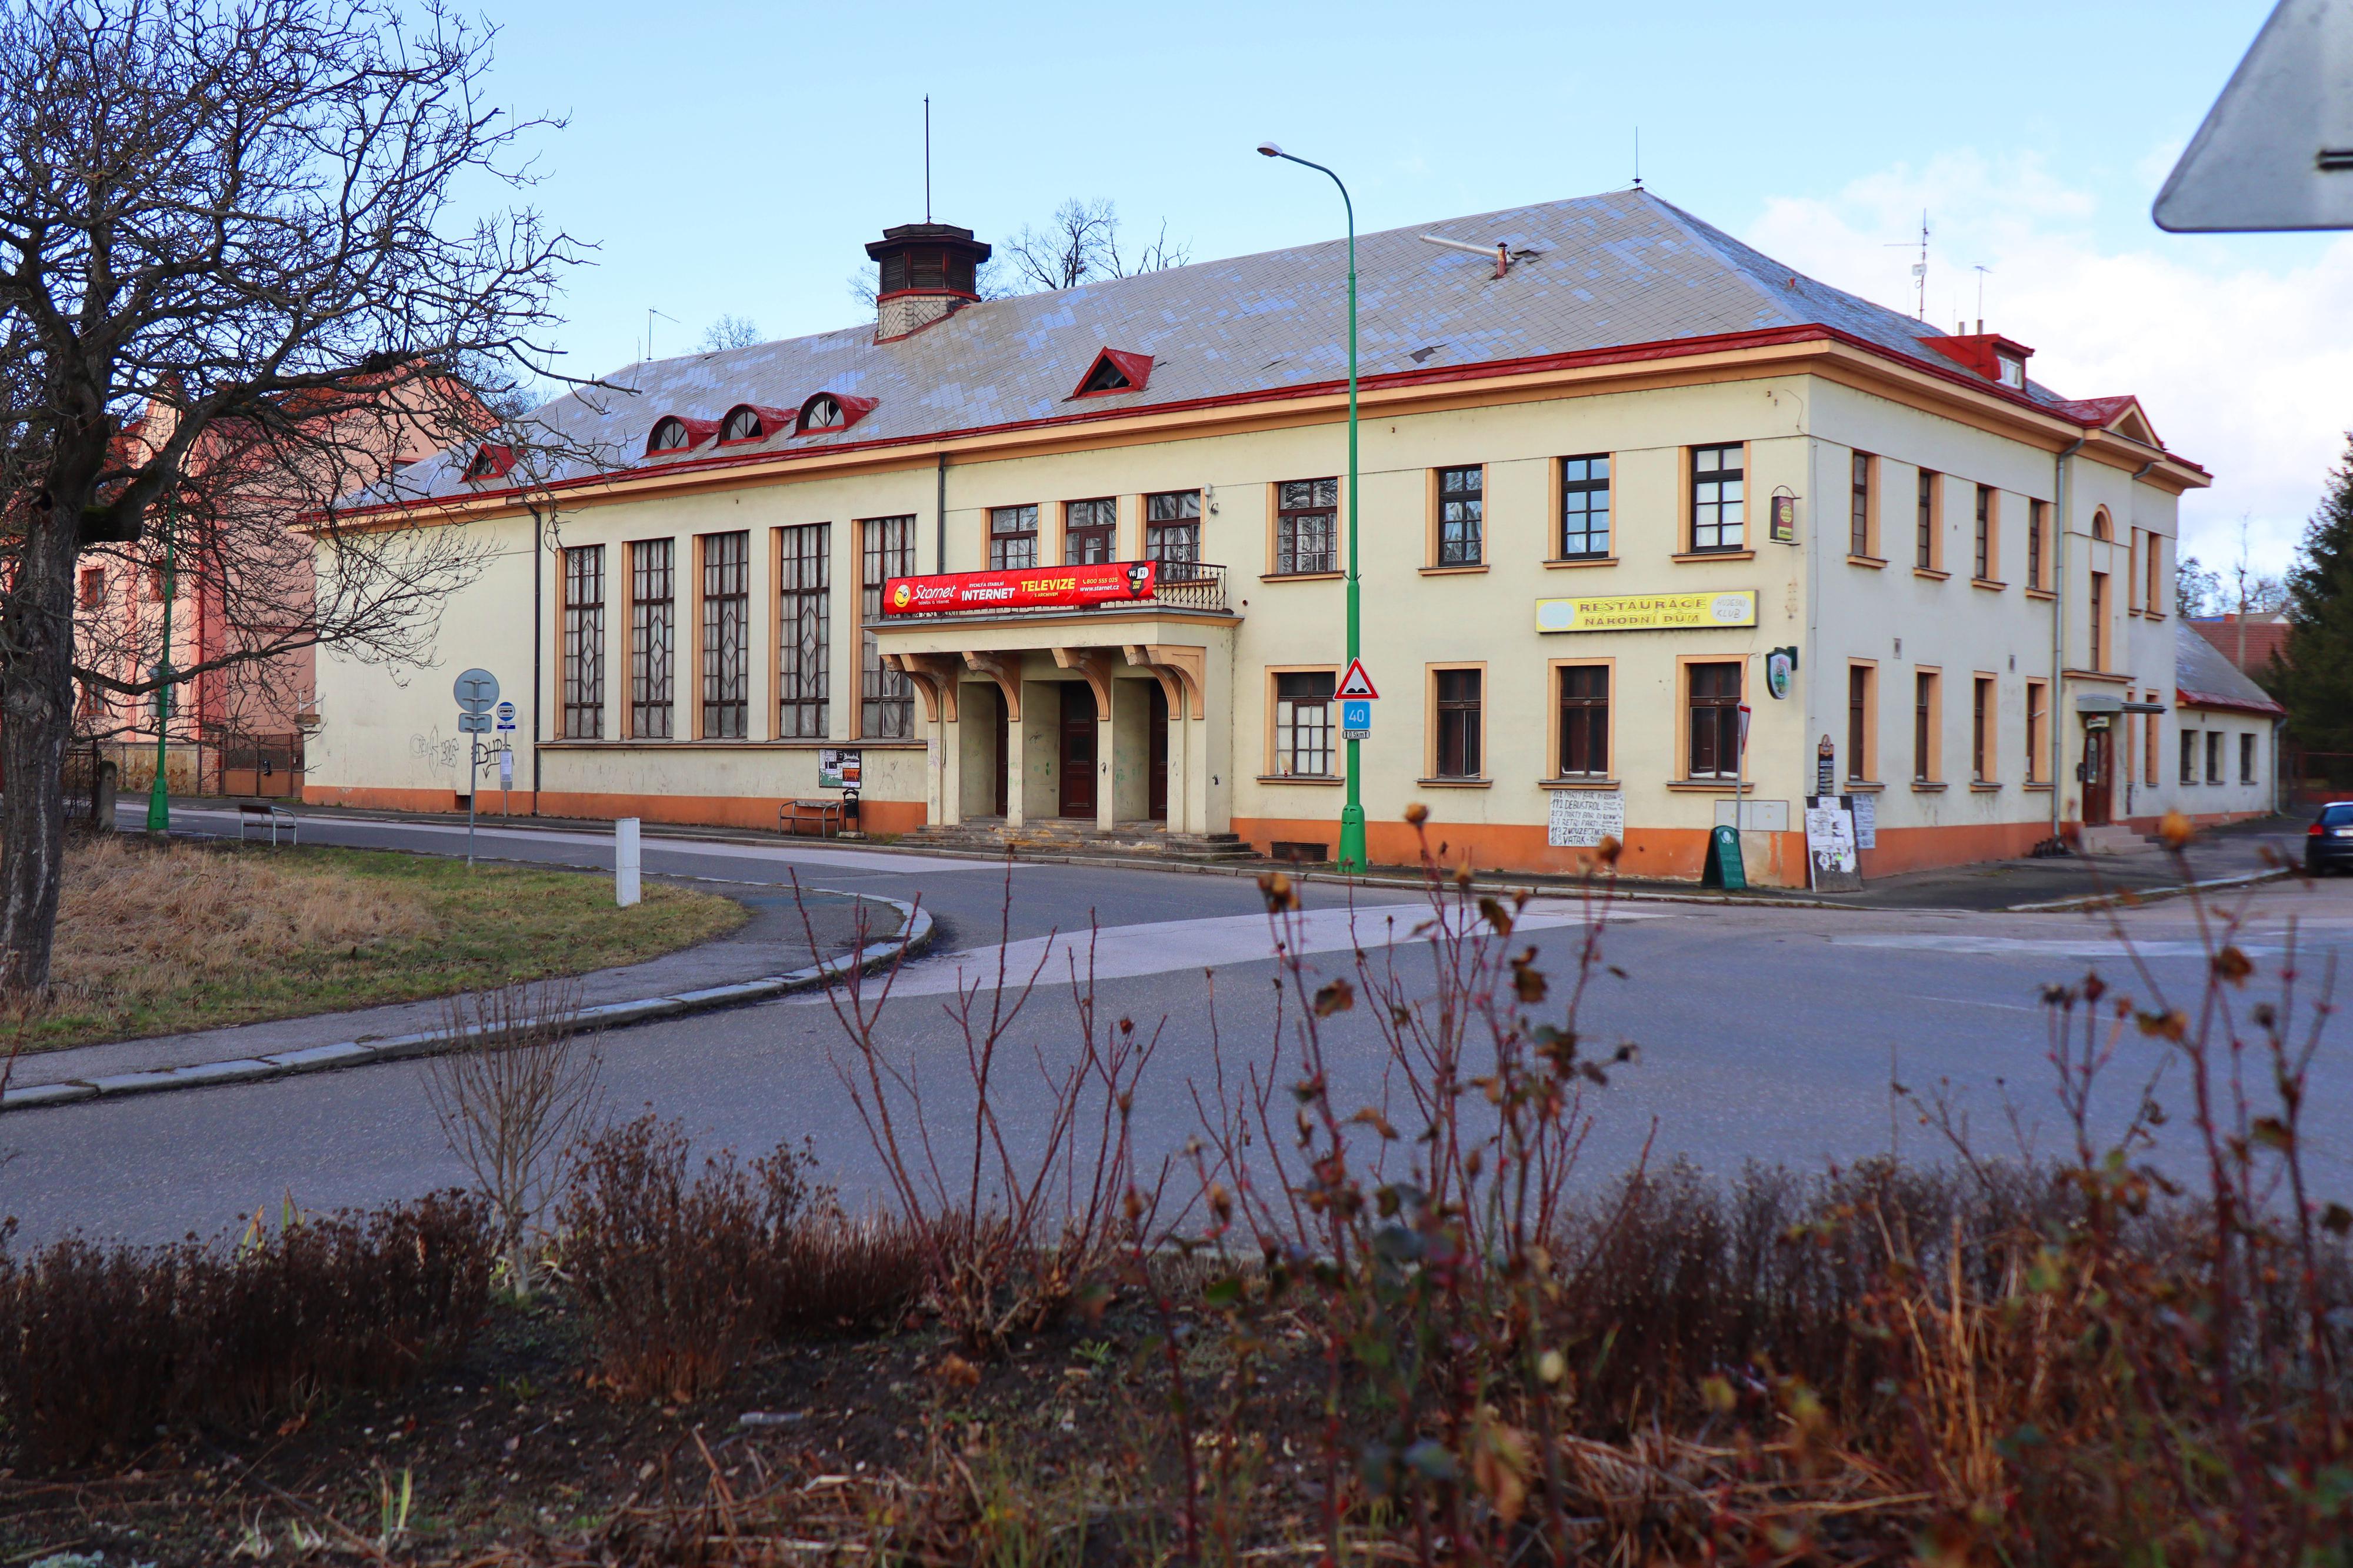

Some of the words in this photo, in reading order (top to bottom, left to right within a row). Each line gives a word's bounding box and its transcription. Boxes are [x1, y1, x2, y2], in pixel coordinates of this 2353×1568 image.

[1021, 578, 1076, 592] TELEVIZE
[913, 584, 956, 600] Starnet
[961, 588, 1016, 601] INTERNET
[1579, 598, 1706, 612] RESTAURACE
[1585, 612, 1657, 626] NÁRODNÍ
[1662, 610, 1700, 624] DŮM
[1716, 608, 1741, 618] KLUB
[1348, 709, 1364, 722] 40
[1565, 800, 1601, 810] DEBUSTROL
[1565, 810, 1582, 819] PARTY
[1564, 835, 1586, 845] VATAK
